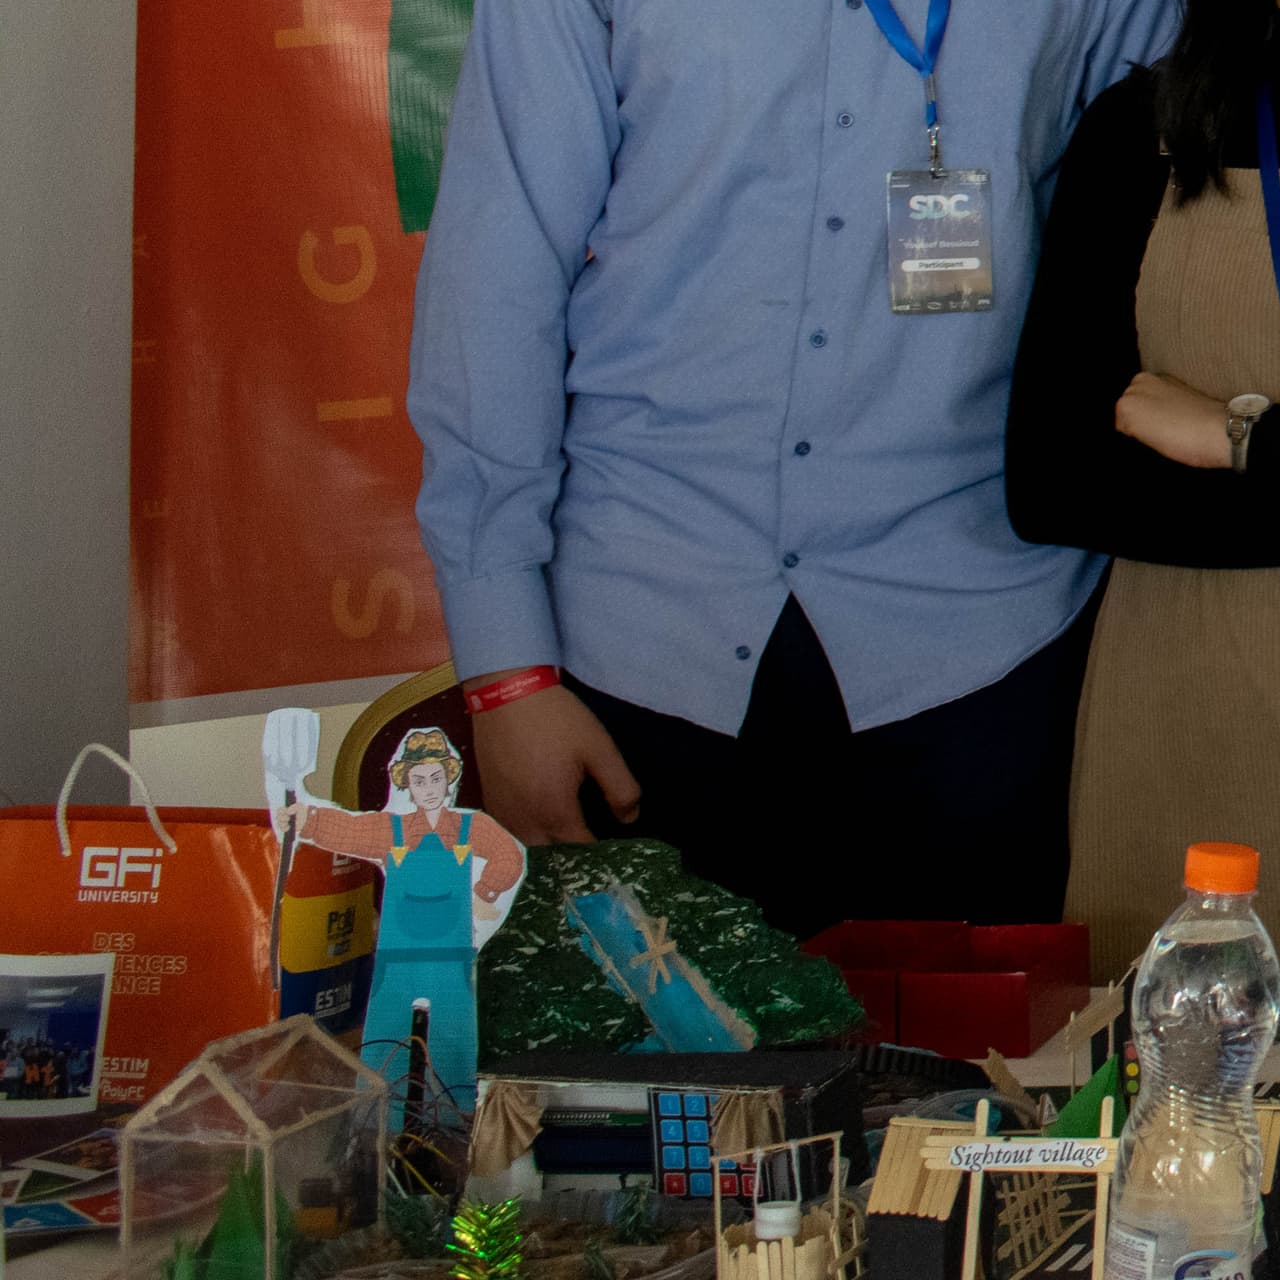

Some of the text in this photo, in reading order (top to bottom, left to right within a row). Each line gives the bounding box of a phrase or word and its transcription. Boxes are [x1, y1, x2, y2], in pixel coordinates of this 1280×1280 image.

[909, 194, 971, 220] SDC
[78, 890, 160, 903] UNIVERSITY
[93, 932, 136, 951] DES
[102, 1057, 149, 1072] ESTIM
[951, 1141, 1105, 1172] Sightout village
